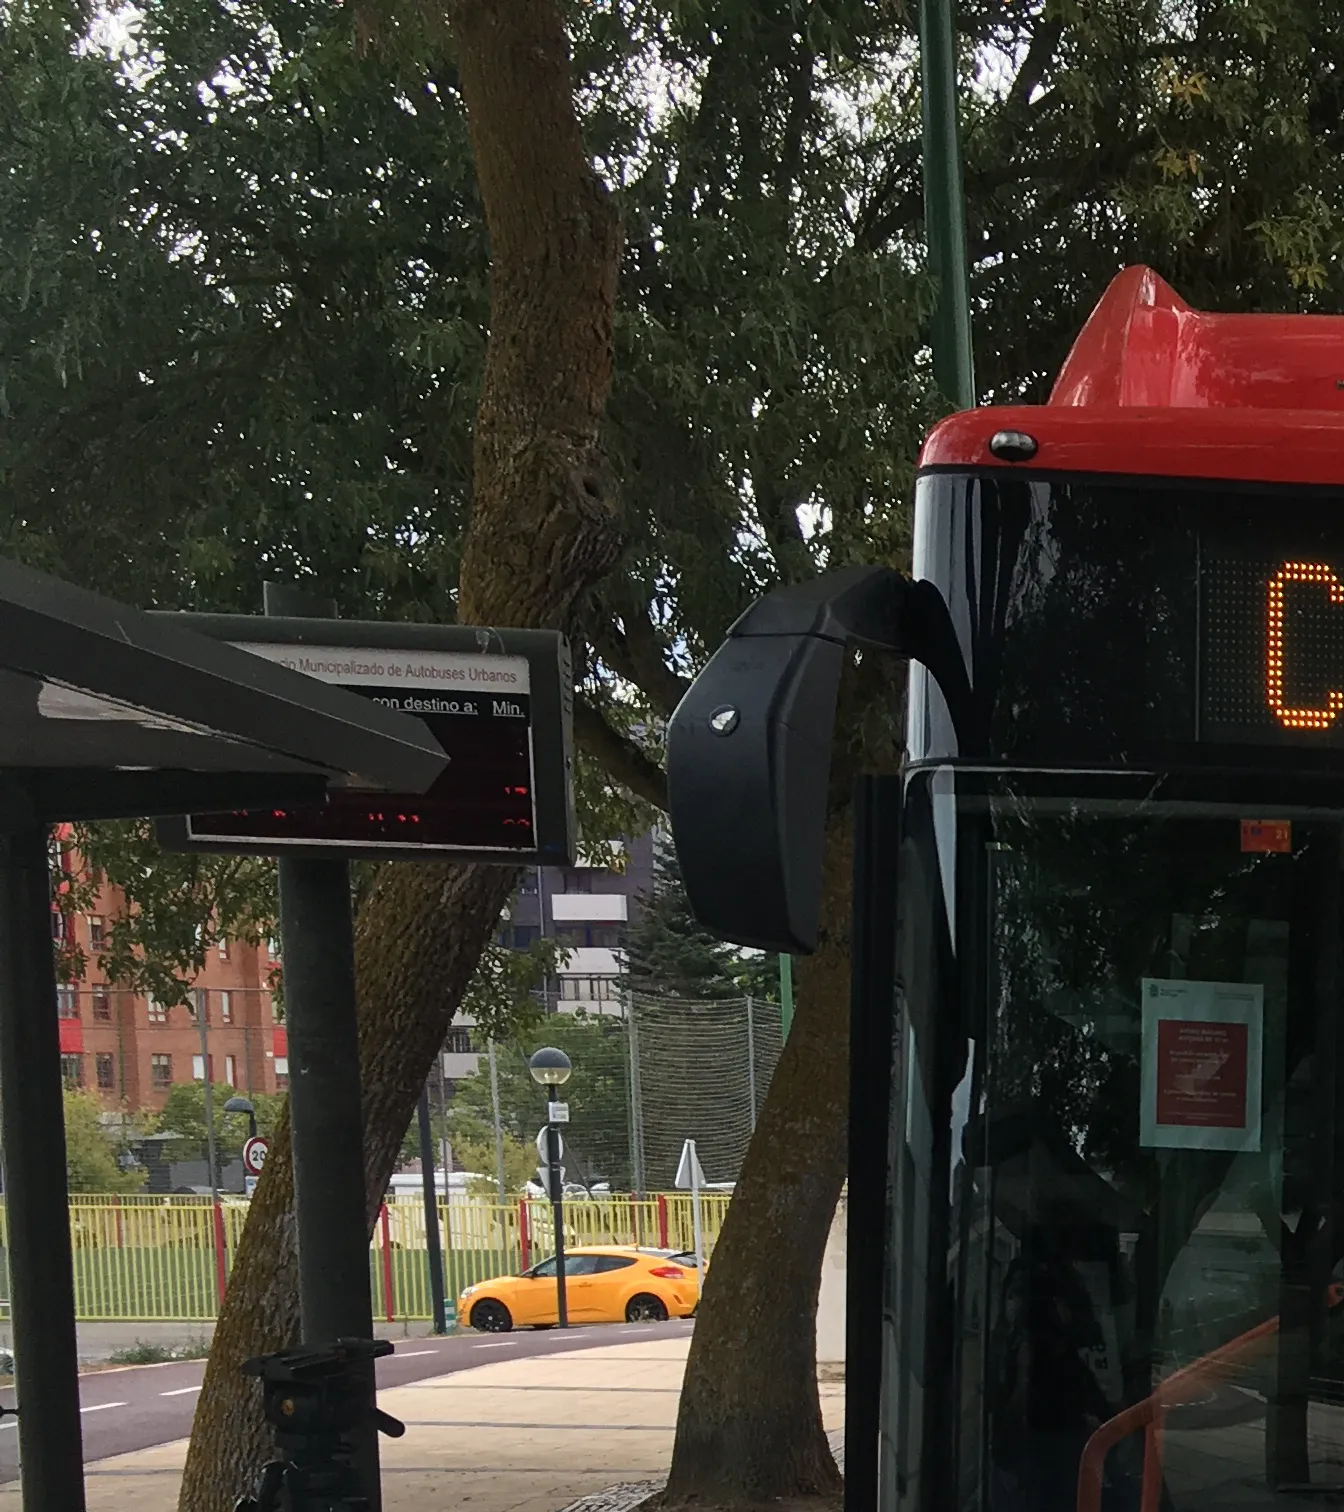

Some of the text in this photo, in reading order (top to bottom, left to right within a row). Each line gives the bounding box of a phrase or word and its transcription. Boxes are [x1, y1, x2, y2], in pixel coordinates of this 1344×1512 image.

[299, 658, 385, 677] Municipalizado
[388, 663, 402, 677] de
[405, 663, 465, 681] Autobuses
[469, 667, 517, 684] Urbanos
[403, 697, 460, 712] destino
[463, 701, 478, 714] a:
[493, 701, 525, 715] Min.
